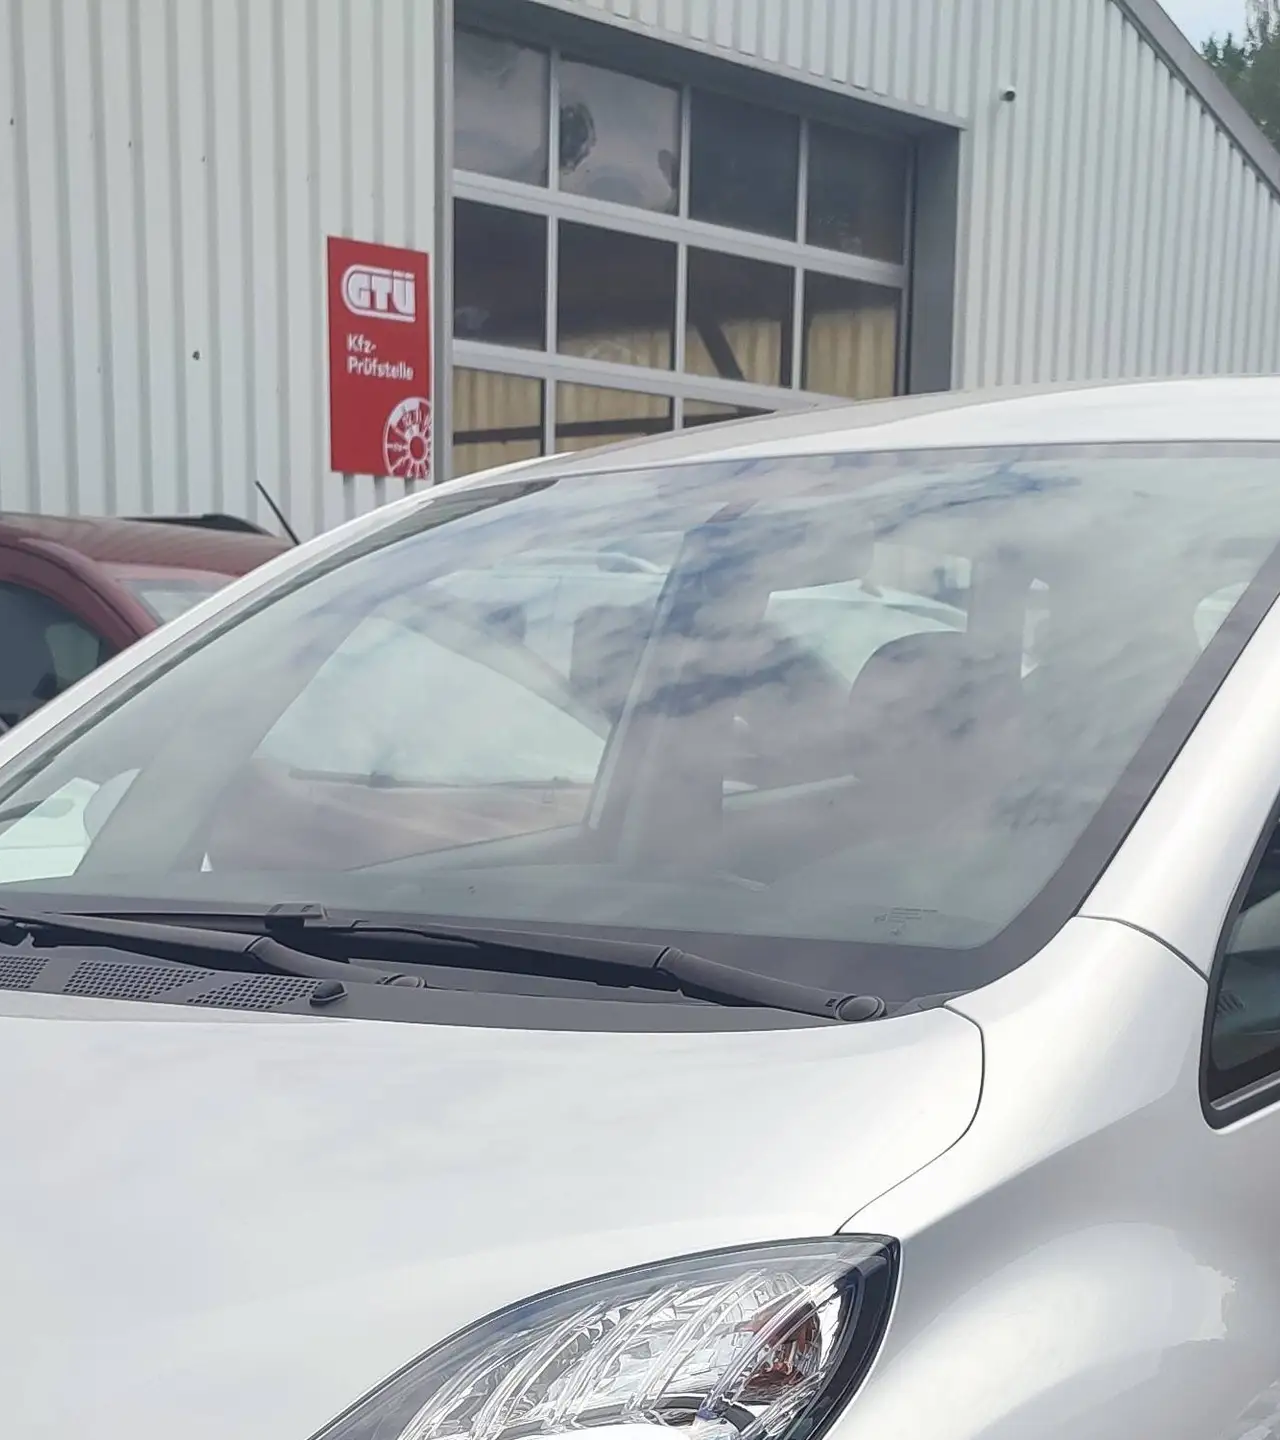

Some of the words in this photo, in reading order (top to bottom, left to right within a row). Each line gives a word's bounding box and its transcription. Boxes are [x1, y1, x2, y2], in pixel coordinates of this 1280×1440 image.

[344, 268, 415, 319] GTÜ
[347, 333, 377, 353] Kfz-
[347, 355, 414, 381] Prüfstelle
